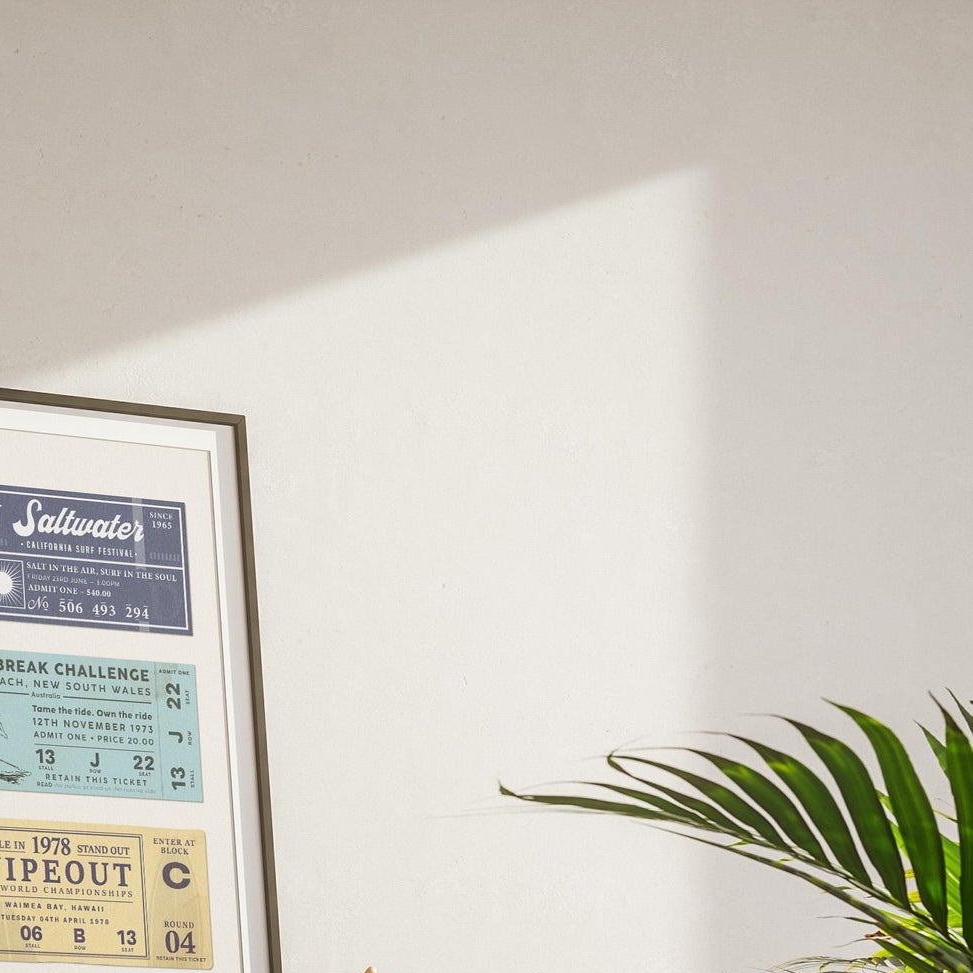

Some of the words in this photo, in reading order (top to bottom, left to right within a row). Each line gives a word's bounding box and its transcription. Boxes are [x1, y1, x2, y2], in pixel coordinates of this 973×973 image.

[12, 499, 144, 542] Saltwater
[149, 512, 173, 520] SINCE
[152, 521, 172, 529] 1965
[27, 541, 72, 552] CALIFORNIA
[76, 545, 94, 554] SURF
[98, 547, 133, 558] FESTIVAL
[27, 562, 46, 570] SALT
[61, 565, 79, 573] THE
[81, 567, 98, 575] AIR,
[100, 568, 121, 577] SURF
[155, 573, 177, 581] SOUL
[28, 584, 57, 592] ADMIT
[60, 586, 78, 594] ONE
[59, 601, 83, 613] 506
[92, 604, 116, 616] 493
[126, 607, 149, 619] 294
[54, 663, 149, 681] CHALLENGE
[33, 680, 60, 689] NEW
[66, 682, 106, 692] SOUTH
[112, 686, 151, 696] WALES
[166, 683, 181, 710] 22
[32, 705, 56, 713] Tame
[58, 707, 72, 715] the
[75, 708, 95, 716] tide.
[96, 710, 117, 718] Own
[119, 711, 132, 719] the
[135, 712, 153, 720] ride
[32, 718, 58, 727] 12TH
[64, 720, 126, 732] NOVEMBER
[130, 725, 153, 733] 1973
[34, 731, 63, 739] ADMIT
[67, 733, 87, 741] ONE
[97, 736, 124, 744] PRICE
[128, 737, 154, 746] 20.00
[169, 731, 183, 743] J
[36, 749, 55, 765] 13
[90, 753, 100, 768] J
[133, 755, 154, 771] 22
[46, 774, 81, 782] RETAIN
[113, 778, 147, 786] TICKET
[171, 767, 186, 790] 13
[15, 841, 25, 849] IN
[32, 836, 71, 856] 1978
[77, 845, 108, 854] STAND
[110, 847, 130, 855] OUT
[153, 838, 182, 846] ENTER
[161, 847, 189, 855] BLOCK
[163, 862, 191, 889] C
[0, 885, 38, 893] WORLD
[43, 886, 133, 897] CHAMPIONSHIPS
[164, 921, 194, 929] ROUND
[20, 925, 42, 941] 06
[74, 928, 85, 943] B
[117, 930, 137, 945] 13
[165, 930, 196, 954] 04
